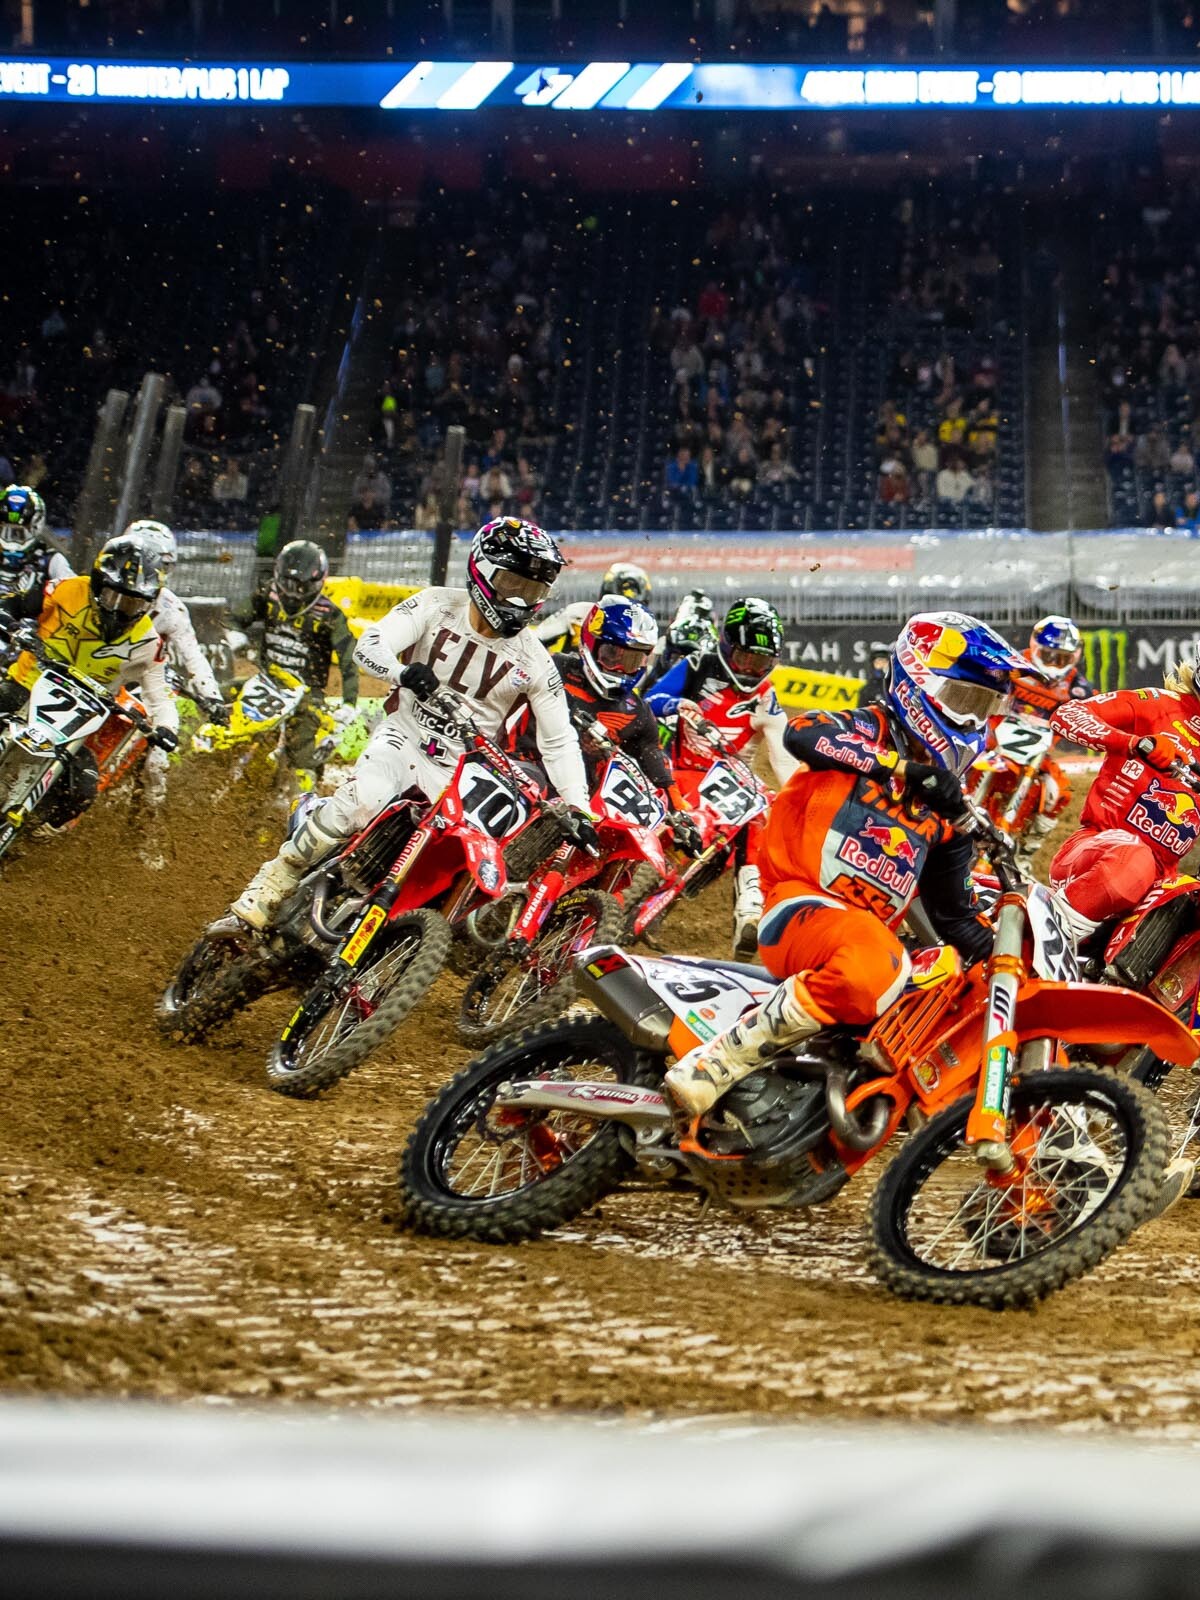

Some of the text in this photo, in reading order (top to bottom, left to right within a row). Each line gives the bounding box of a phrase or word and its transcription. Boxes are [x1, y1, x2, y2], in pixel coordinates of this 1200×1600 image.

[428, 627, 516, 699] FLY
[784, 640, 840, 663] TAH
[1001, 729, 1043, 756] 2
[461, 776, 518, 838] 10
[521, 884, 547, 928] DUNLOP
